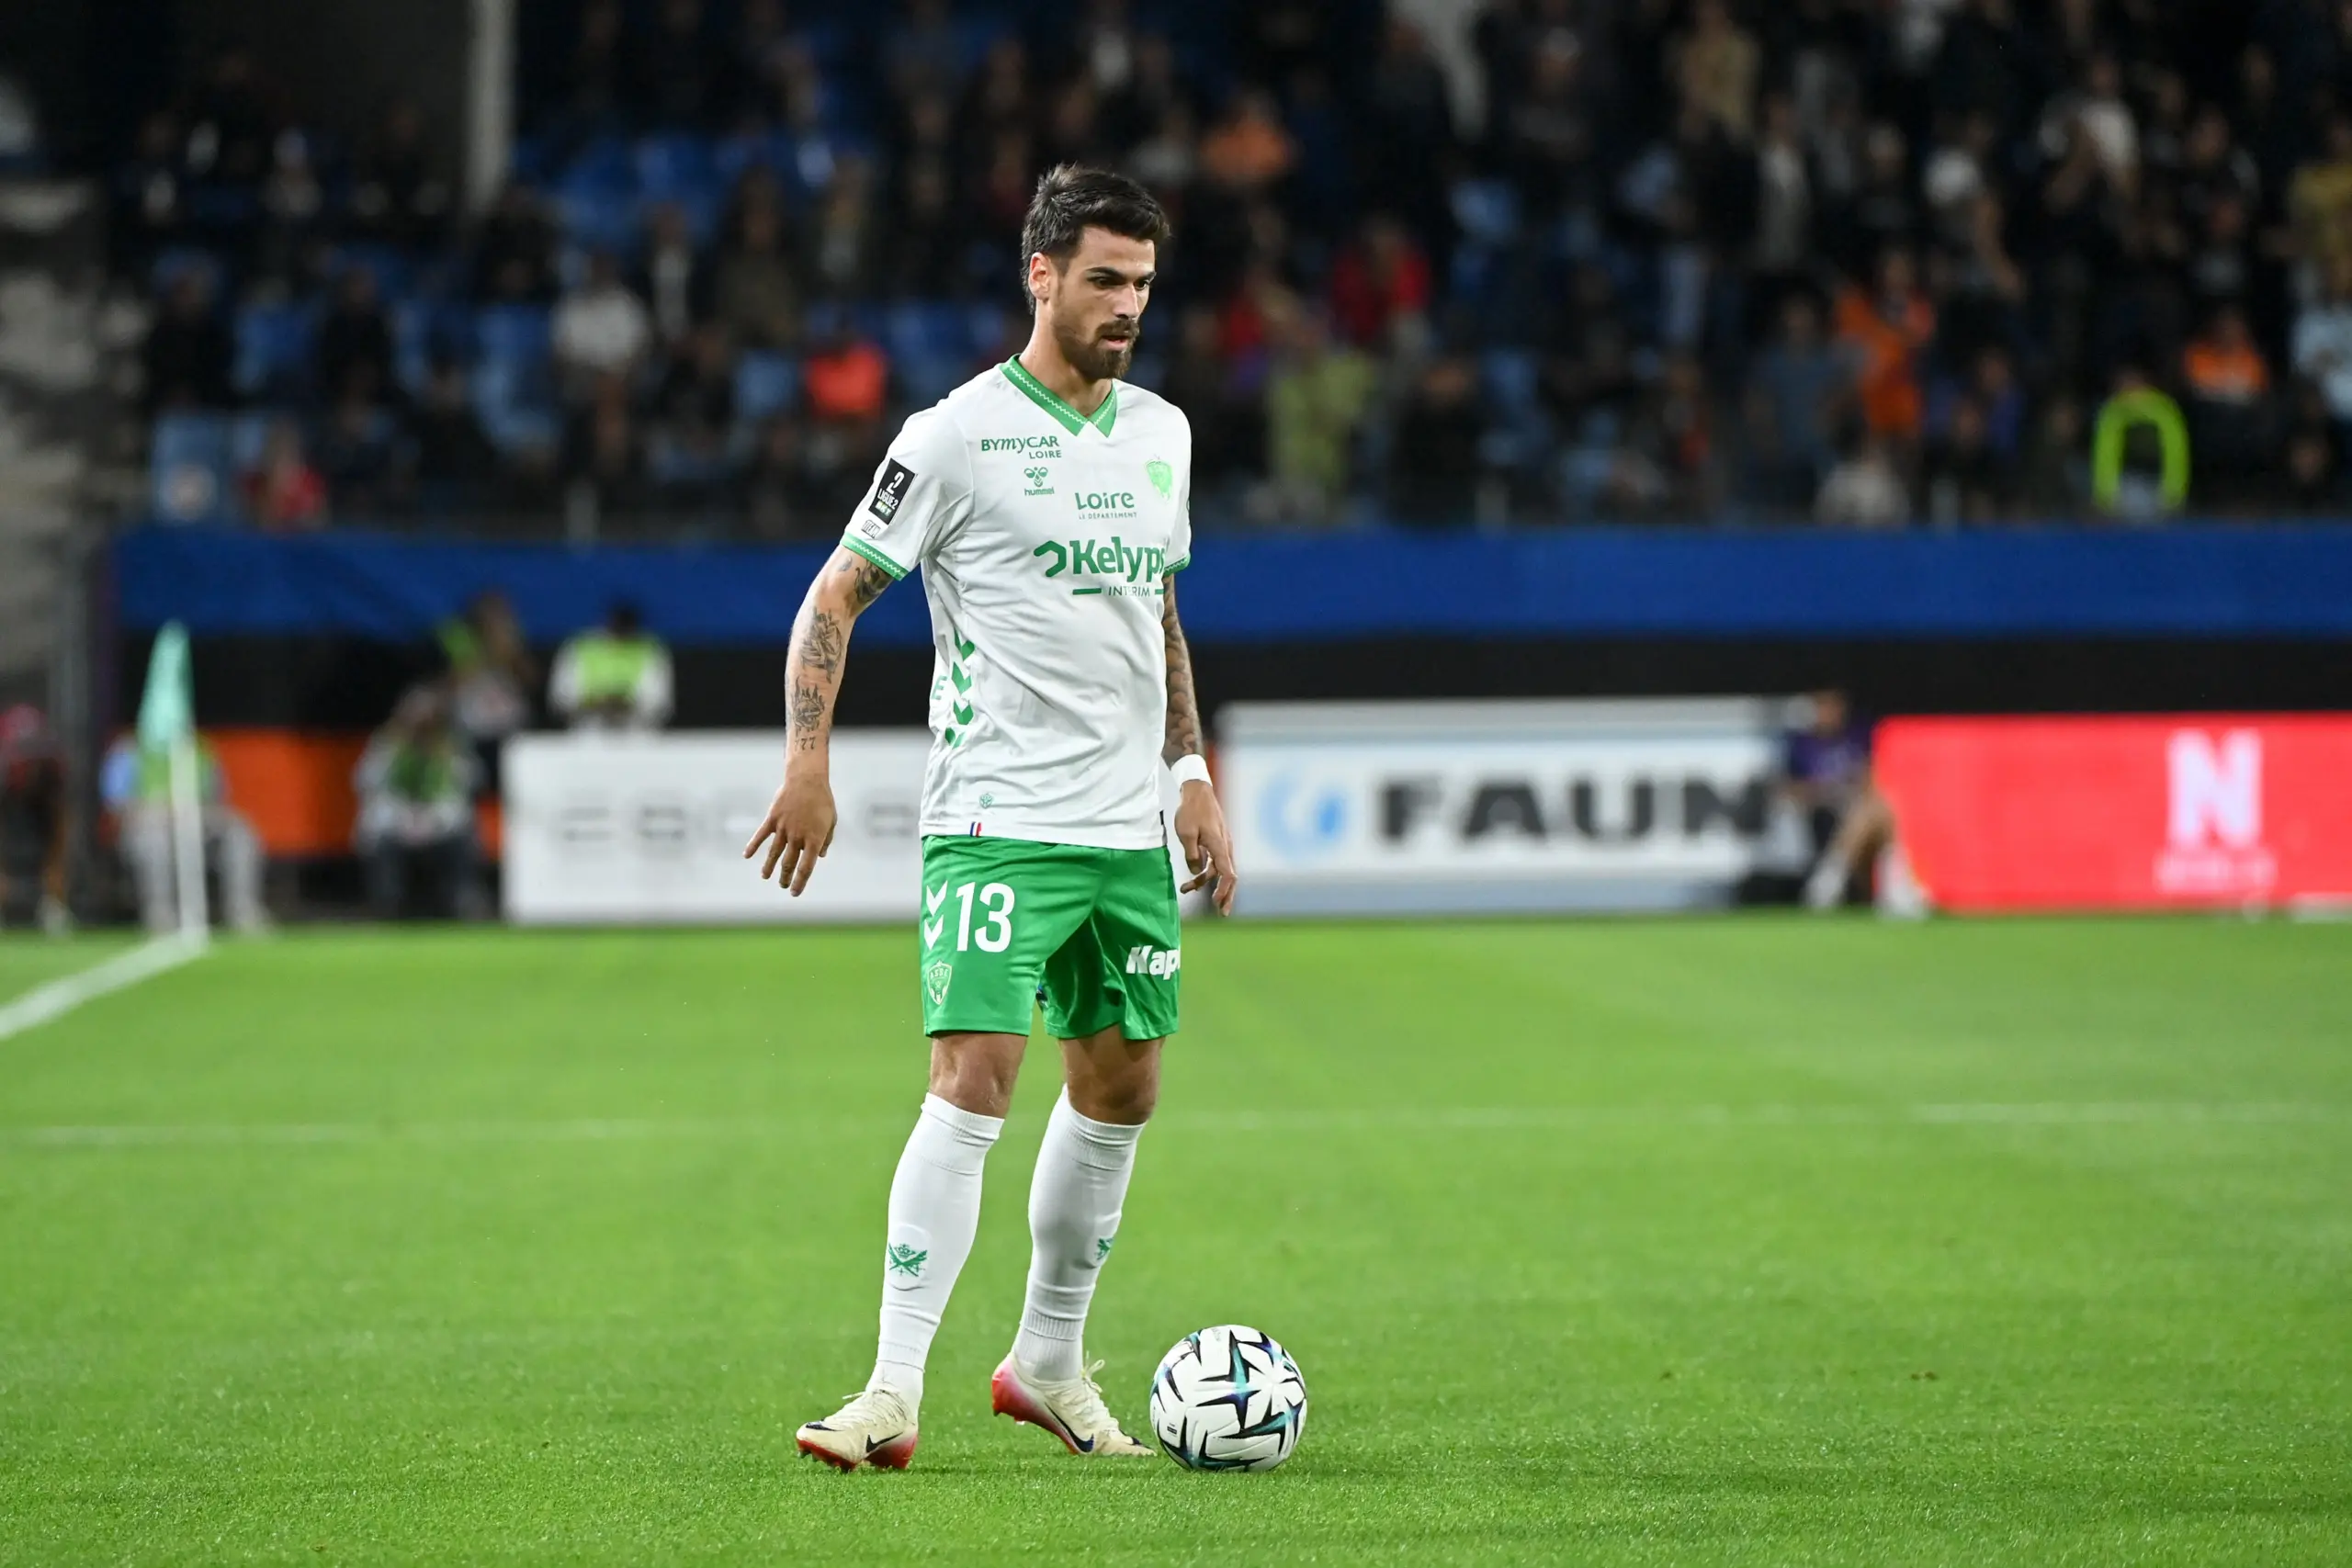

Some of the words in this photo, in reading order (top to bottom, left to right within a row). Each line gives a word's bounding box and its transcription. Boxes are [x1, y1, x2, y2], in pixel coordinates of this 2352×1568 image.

[1029, 450, 1062, 459] LOIRE
[886, 471, 905, 495] 2
[1024, 487, 1055, 496] hummel
[1074, 492, 1136, 510] Loire
[2168, 728, 2262, 849] N
[1377, 773, 1770, 845] FAUN
[955, 881, 1015, 953] 13
[1125, 945, 1181, 980] Kap
